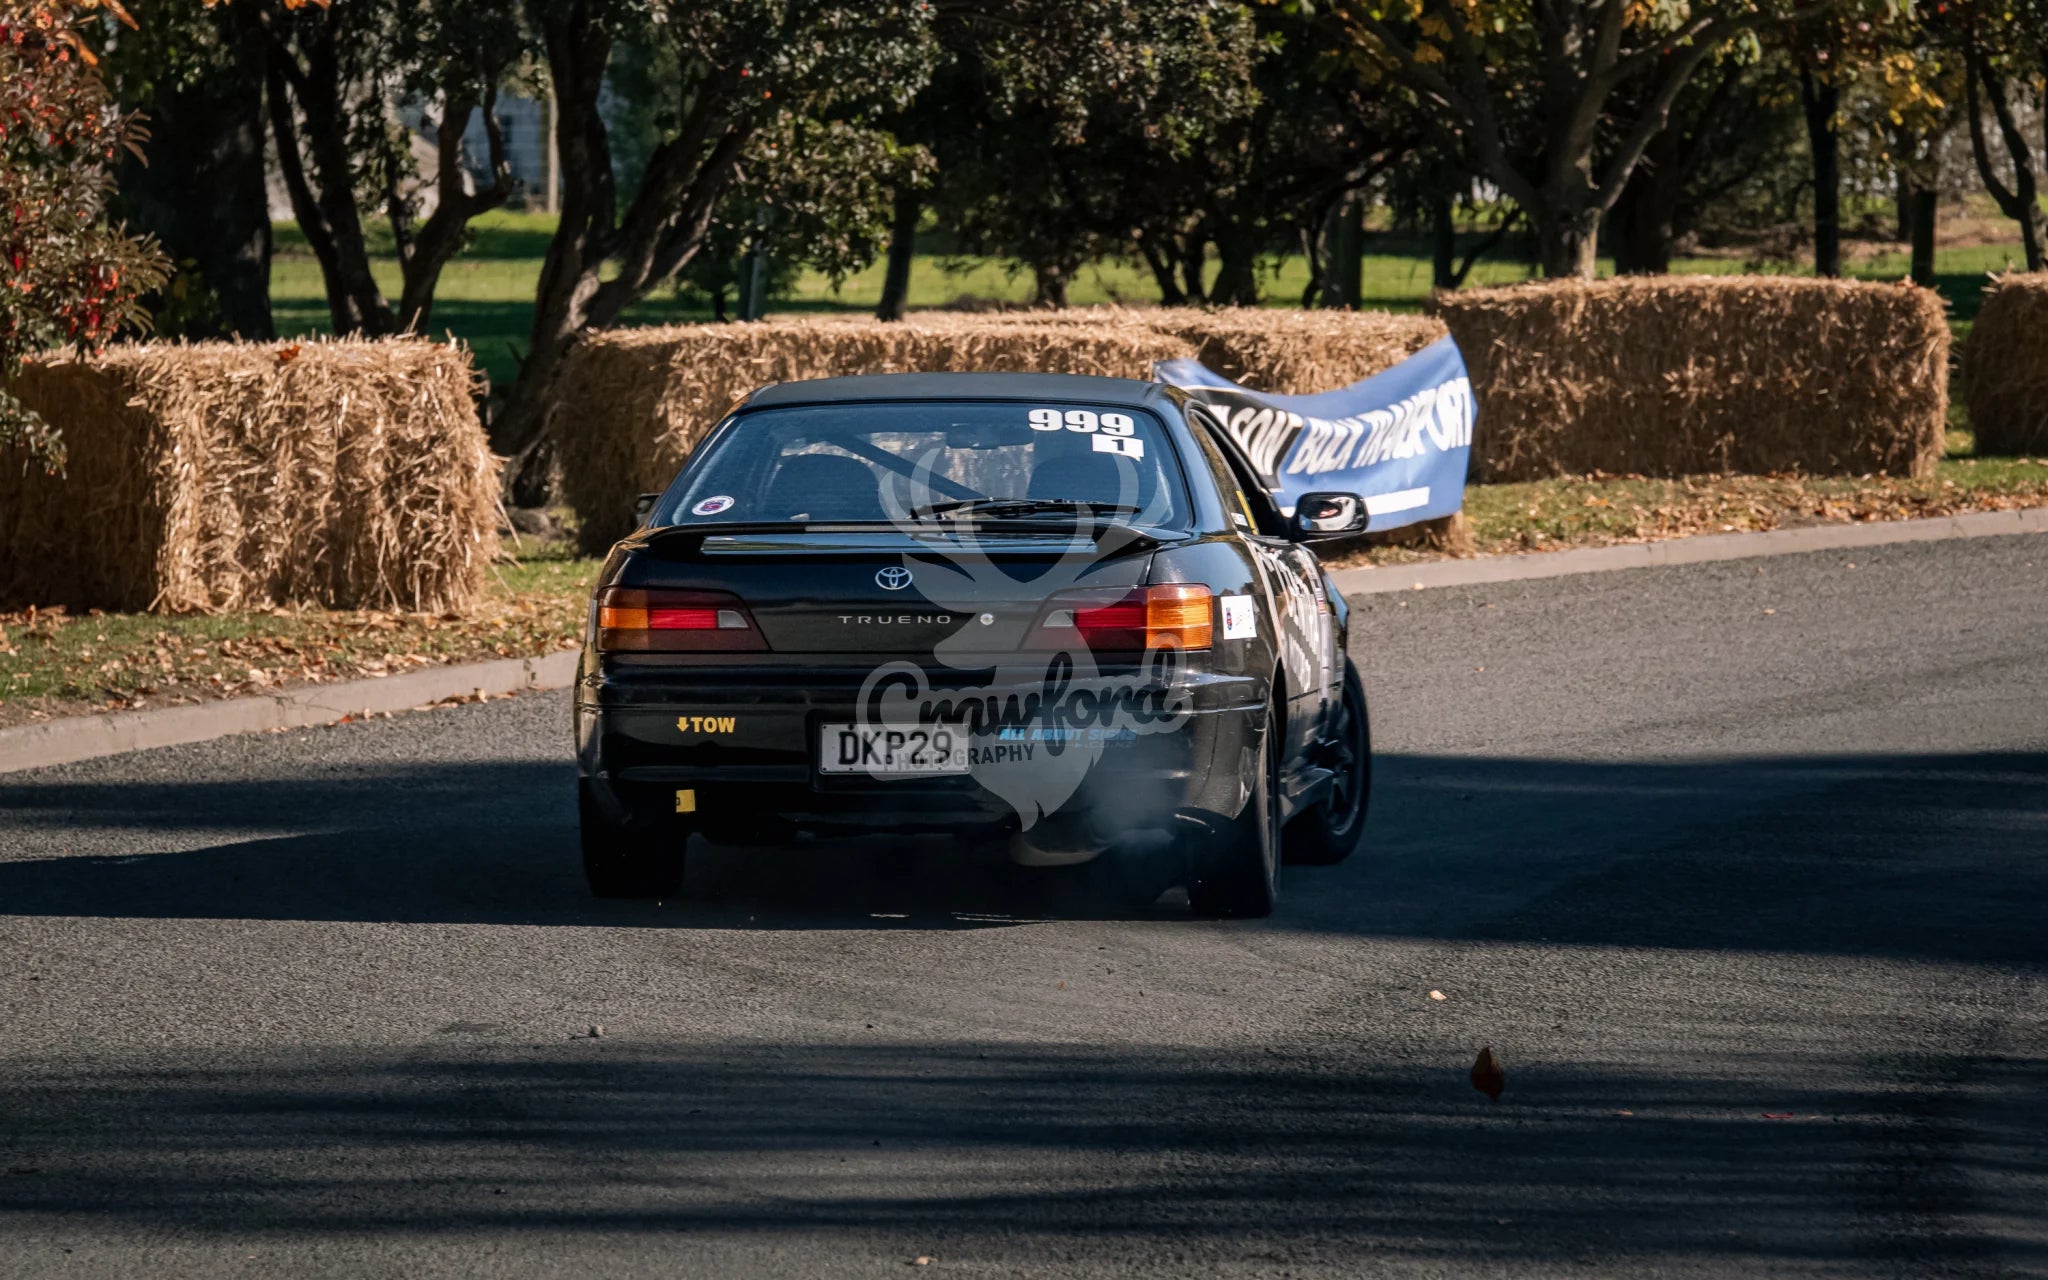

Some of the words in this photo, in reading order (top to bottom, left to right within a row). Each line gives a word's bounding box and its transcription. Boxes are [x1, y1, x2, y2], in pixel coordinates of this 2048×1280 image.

[1028, 408, 1135, 437] 999
[1111, 438, 1125, 452] 1
[837, 615, 951, 624] TRUENO
[690, 716, 736, 733] TOW
[1000, 728, 1025, 741] ALL
[1031, 728, 1084, 741] ABOUT
[838, 730, 954, 766] DKP29
